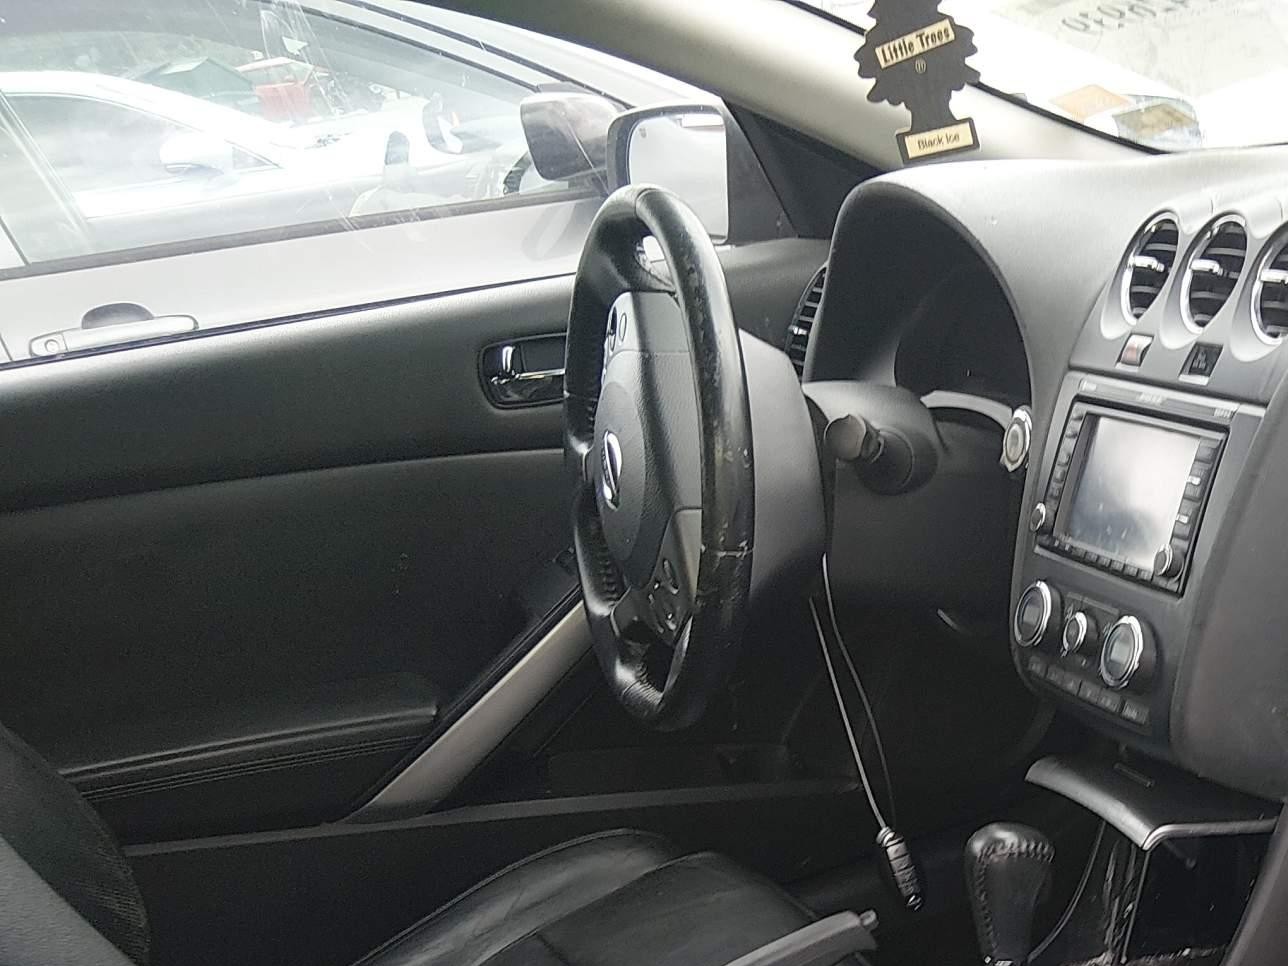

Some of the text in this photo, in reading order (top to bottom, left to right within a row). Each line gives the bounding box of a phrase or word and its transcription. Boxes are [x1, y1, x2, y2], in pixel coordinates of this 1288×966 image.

[882, 28, 951, 65] Little Trees
[917, 131, 960, 151] Black Ice
